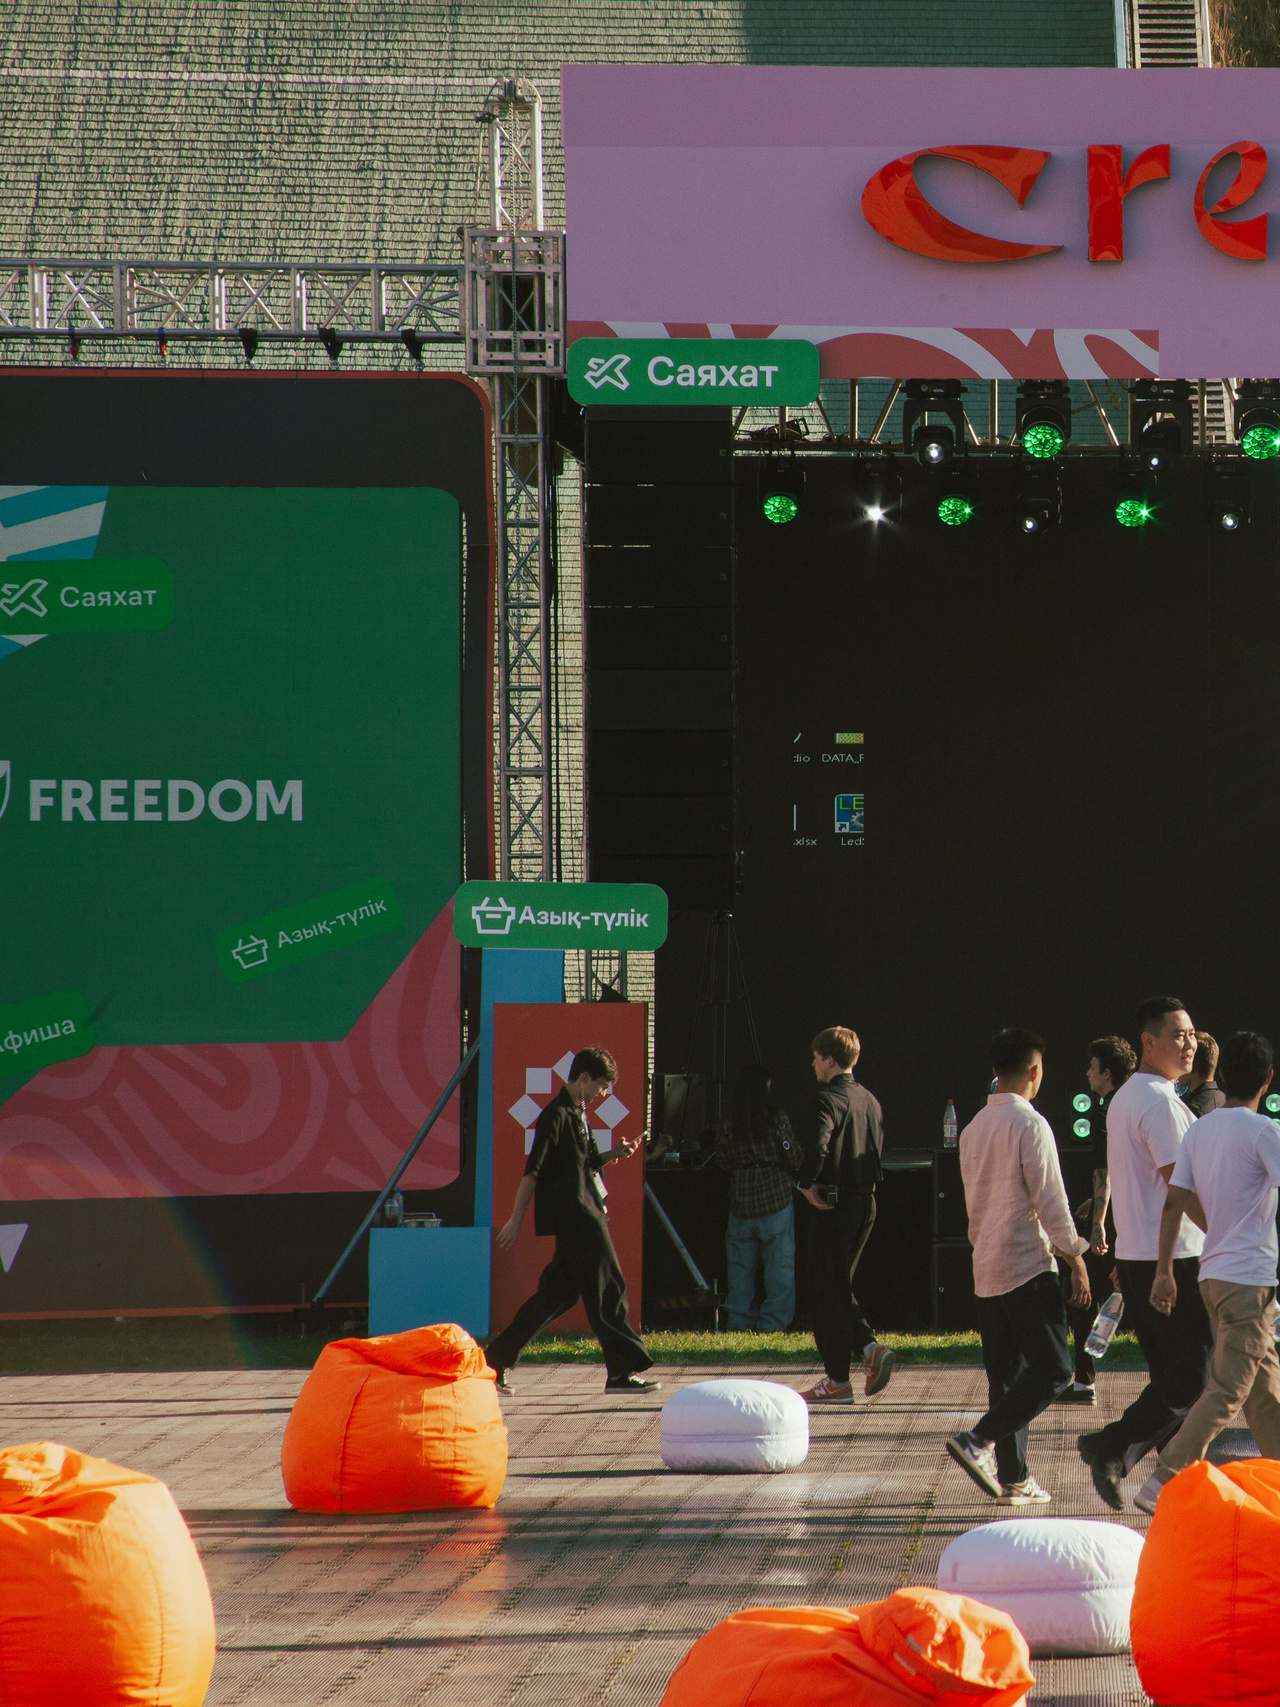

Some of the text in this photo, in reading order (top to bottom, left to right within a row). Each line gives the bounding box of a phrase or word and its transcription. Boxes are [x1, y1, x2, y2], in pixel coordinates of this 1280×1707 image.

[647, 356, 779, 388] Саяхат
[60, 586, 157, 608] Саяхат
[29, 779, 303, 822] FREEDOM
[841, 837, 865, 846] Led
[278, 899, 388, 948] Азық-түлік
[518, 906, 649, 931] Азық-түлік
[0, 1019, 76, 1054] фиша
